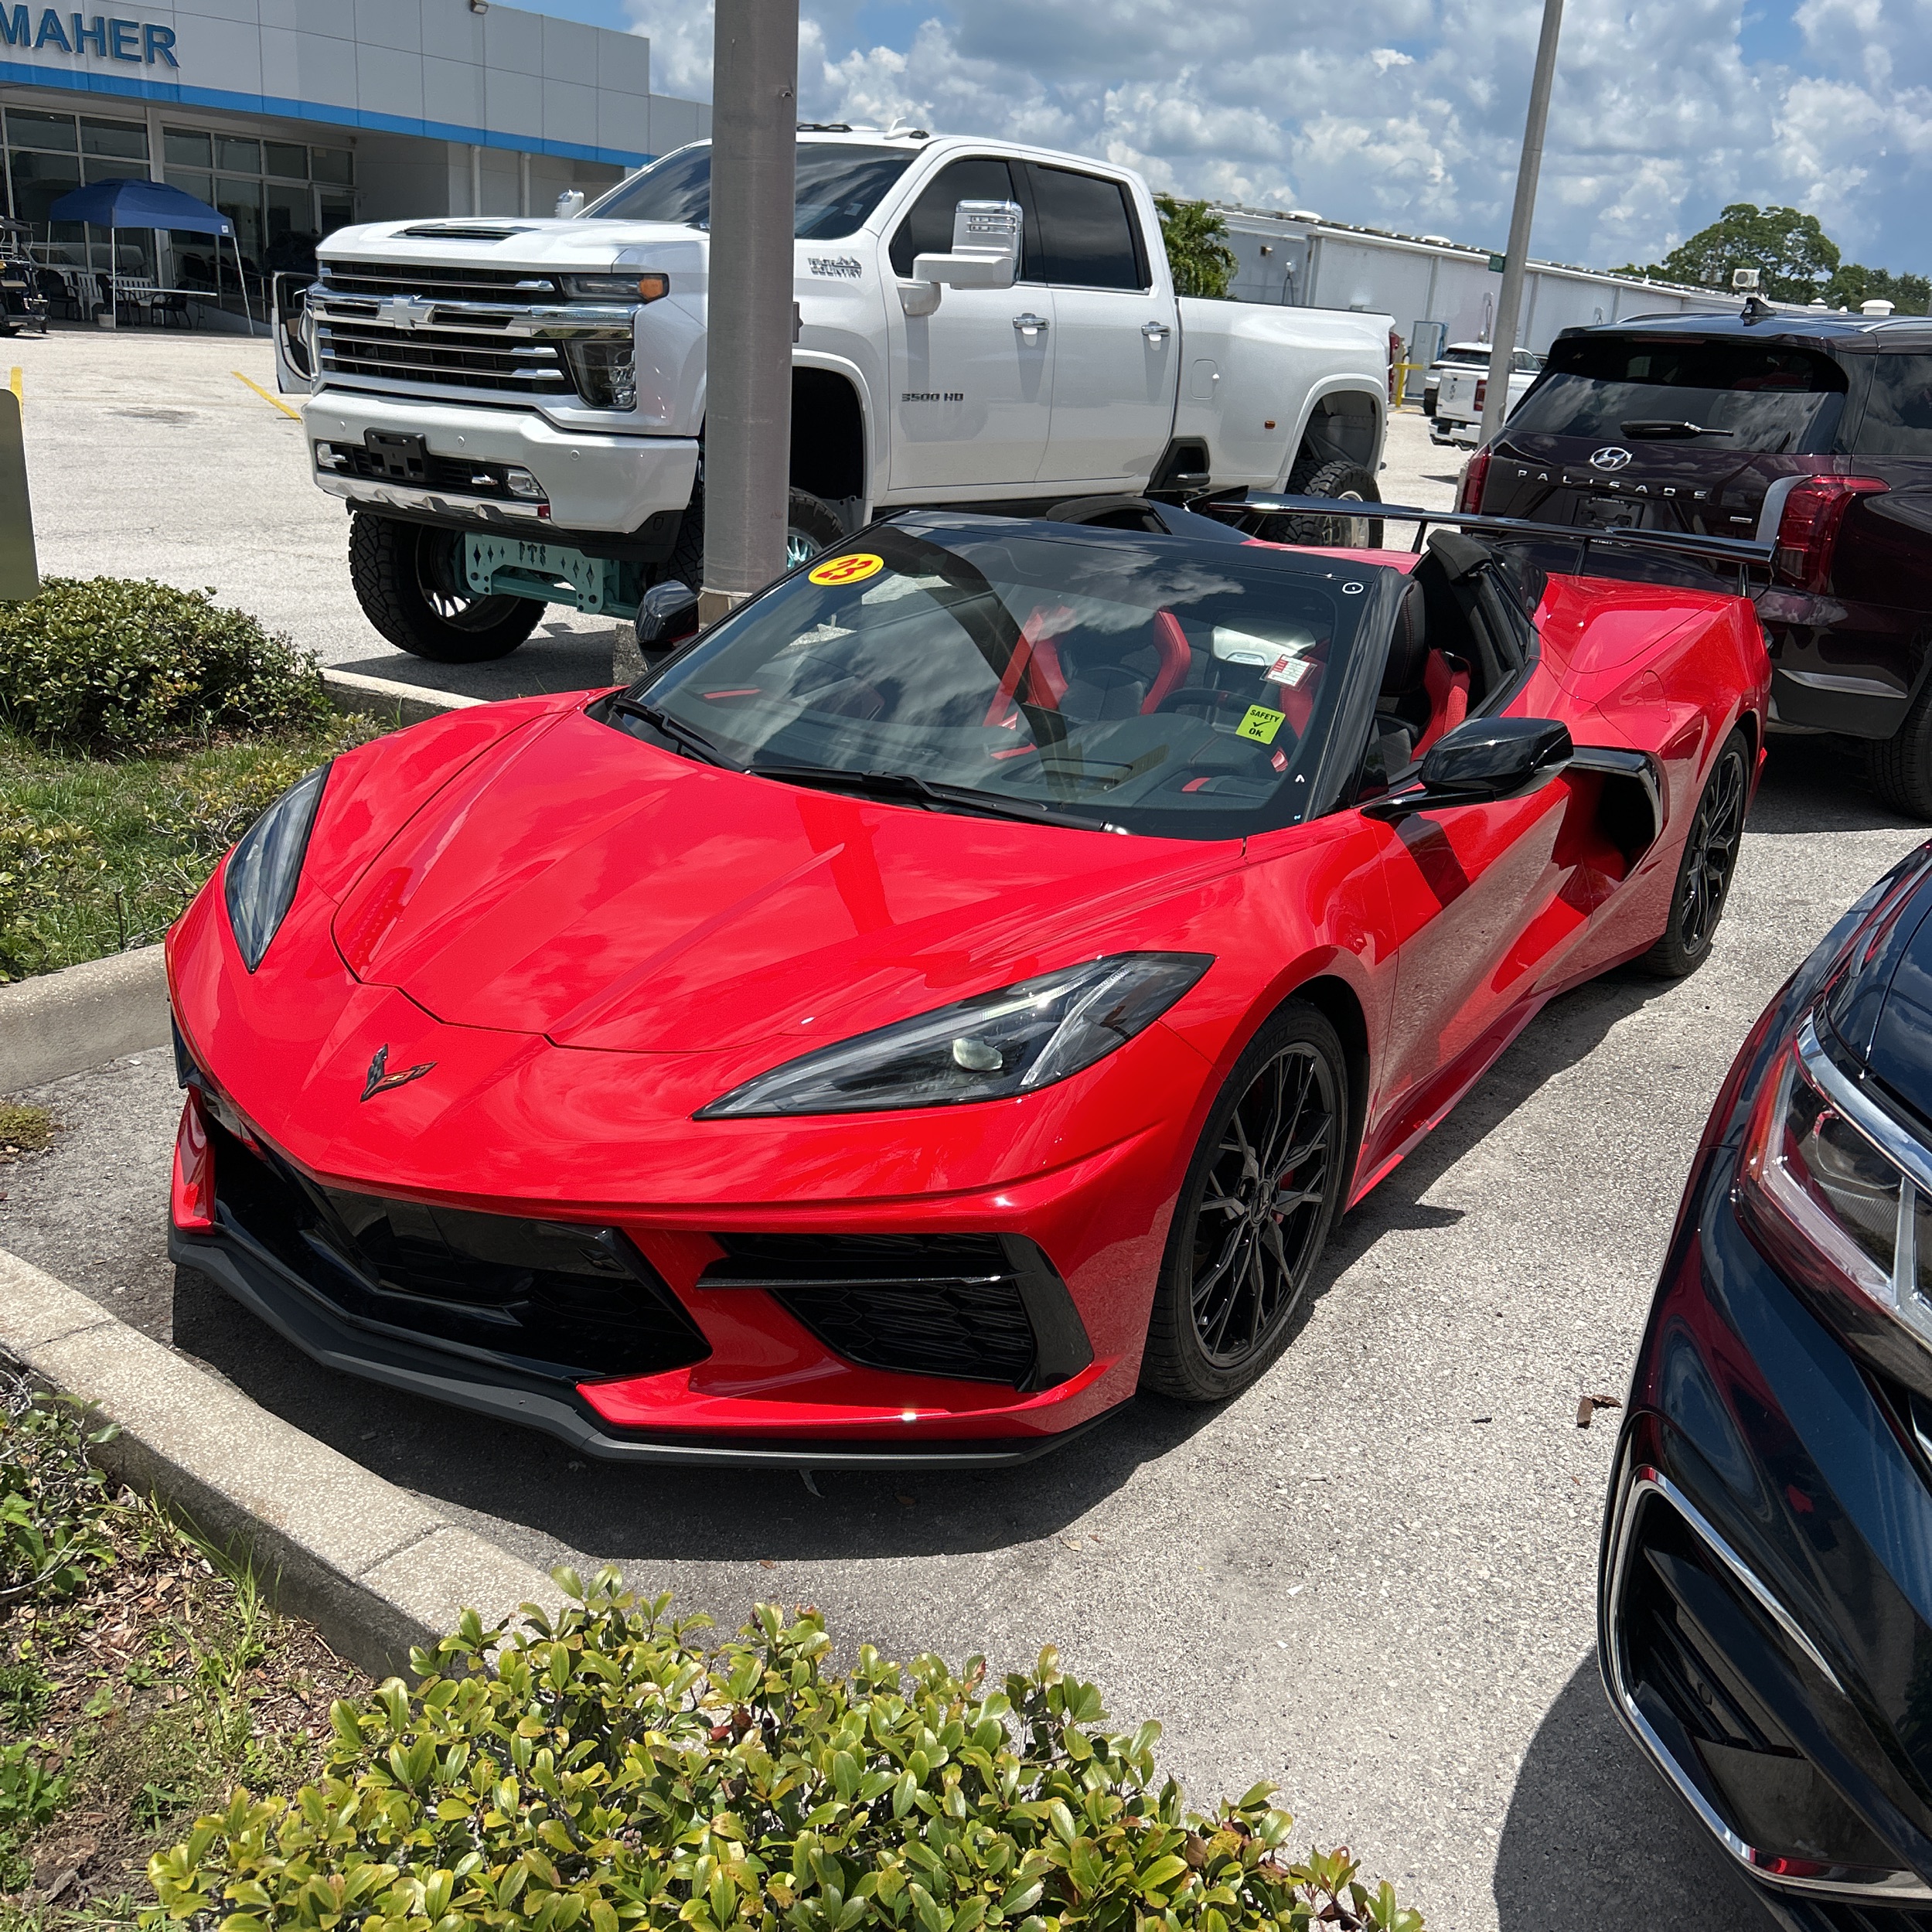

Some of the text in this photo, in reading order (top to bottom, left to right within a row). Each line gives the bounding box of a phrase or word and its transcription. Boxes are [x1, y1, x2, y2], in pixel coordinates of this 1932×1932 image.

[0, 4, 180, 68] MAHER
[901, 393, 963, 402] 3500 HD
[1518, 469, 1707, 499] PALISADE
[815, 557, 874, 580] 23
[1249, 709, 1280, 723] SAFETY
[1249, 727, 1264, 738] OK
